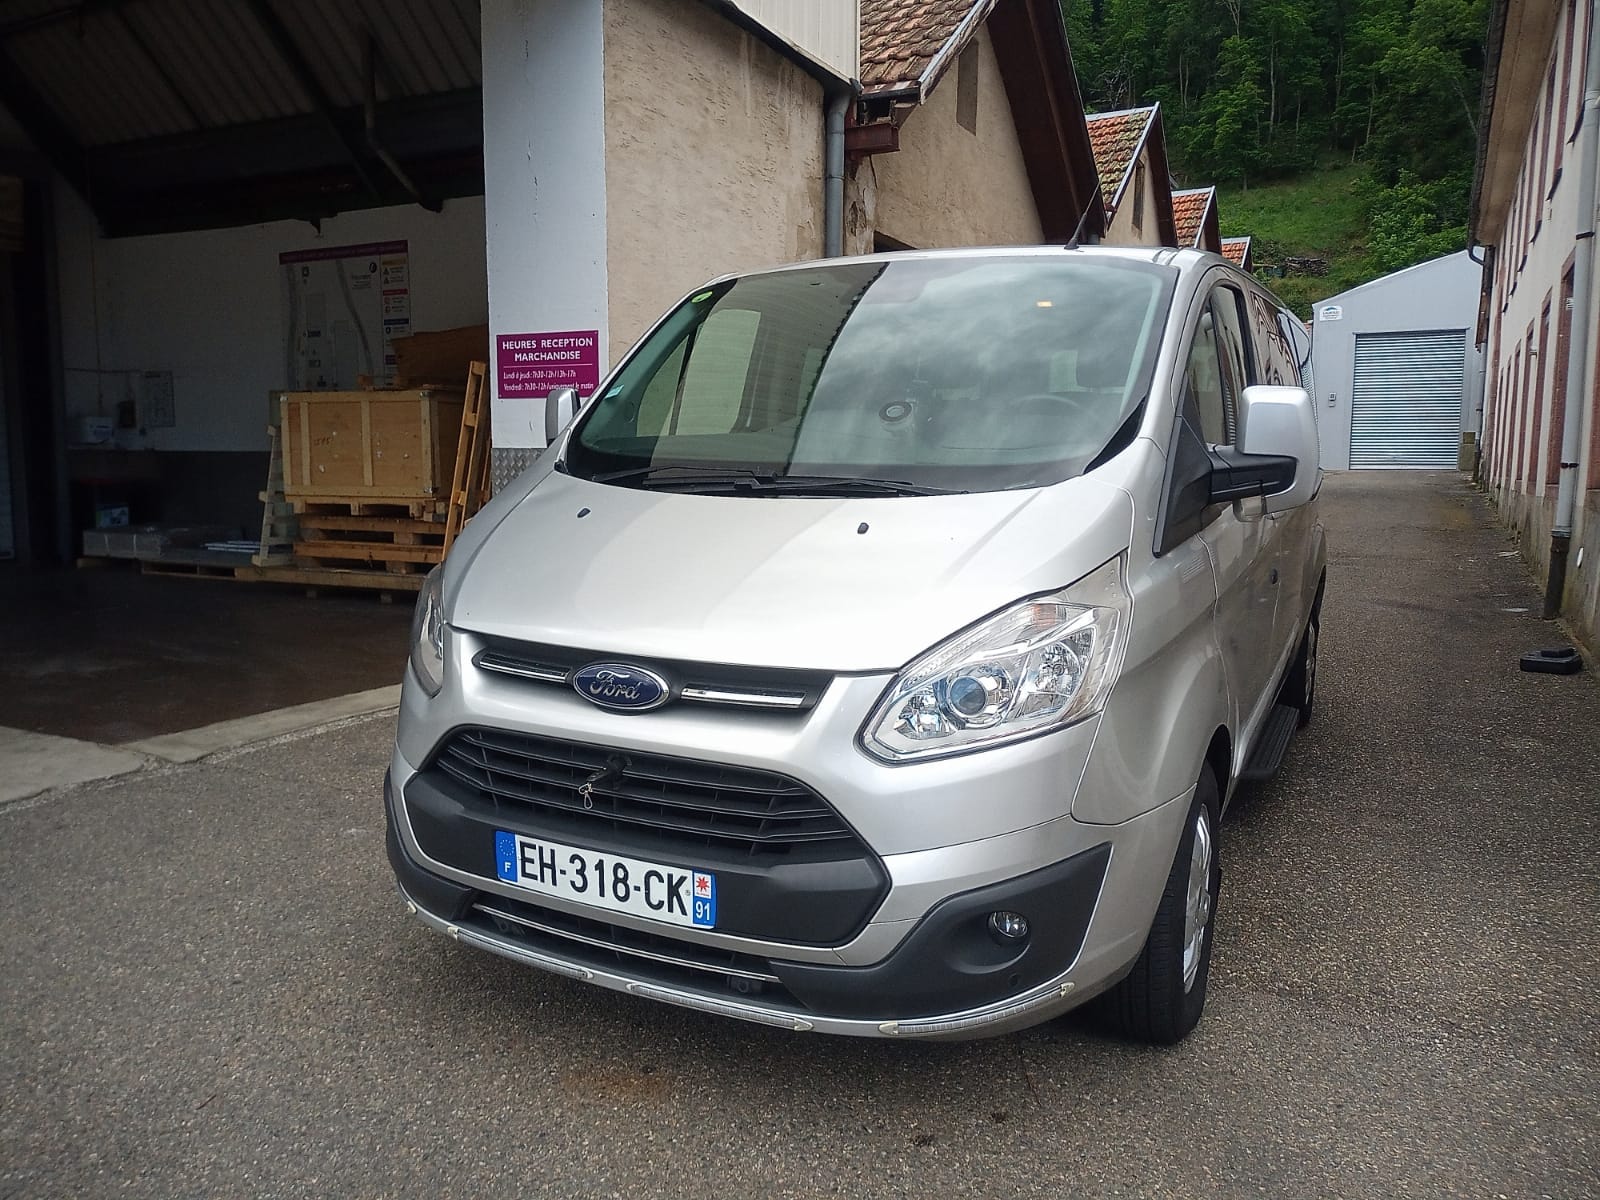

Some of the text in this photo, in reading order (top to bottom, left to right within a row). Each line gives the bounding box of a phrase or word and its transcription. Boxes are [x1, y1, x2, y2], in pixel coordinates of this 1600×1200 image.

[502, 337, 593, 350] HEURES RECEPTION
[514, 350, 581, 362] MARCHANDISE
[503, 371, 515, 379] Lundi
[589, 670, 643, 700] Ford
[504, 862, 512, 873] F
[519, 840, 689, 917] EH-318-CK
[695, 900, 711, 921] 91
